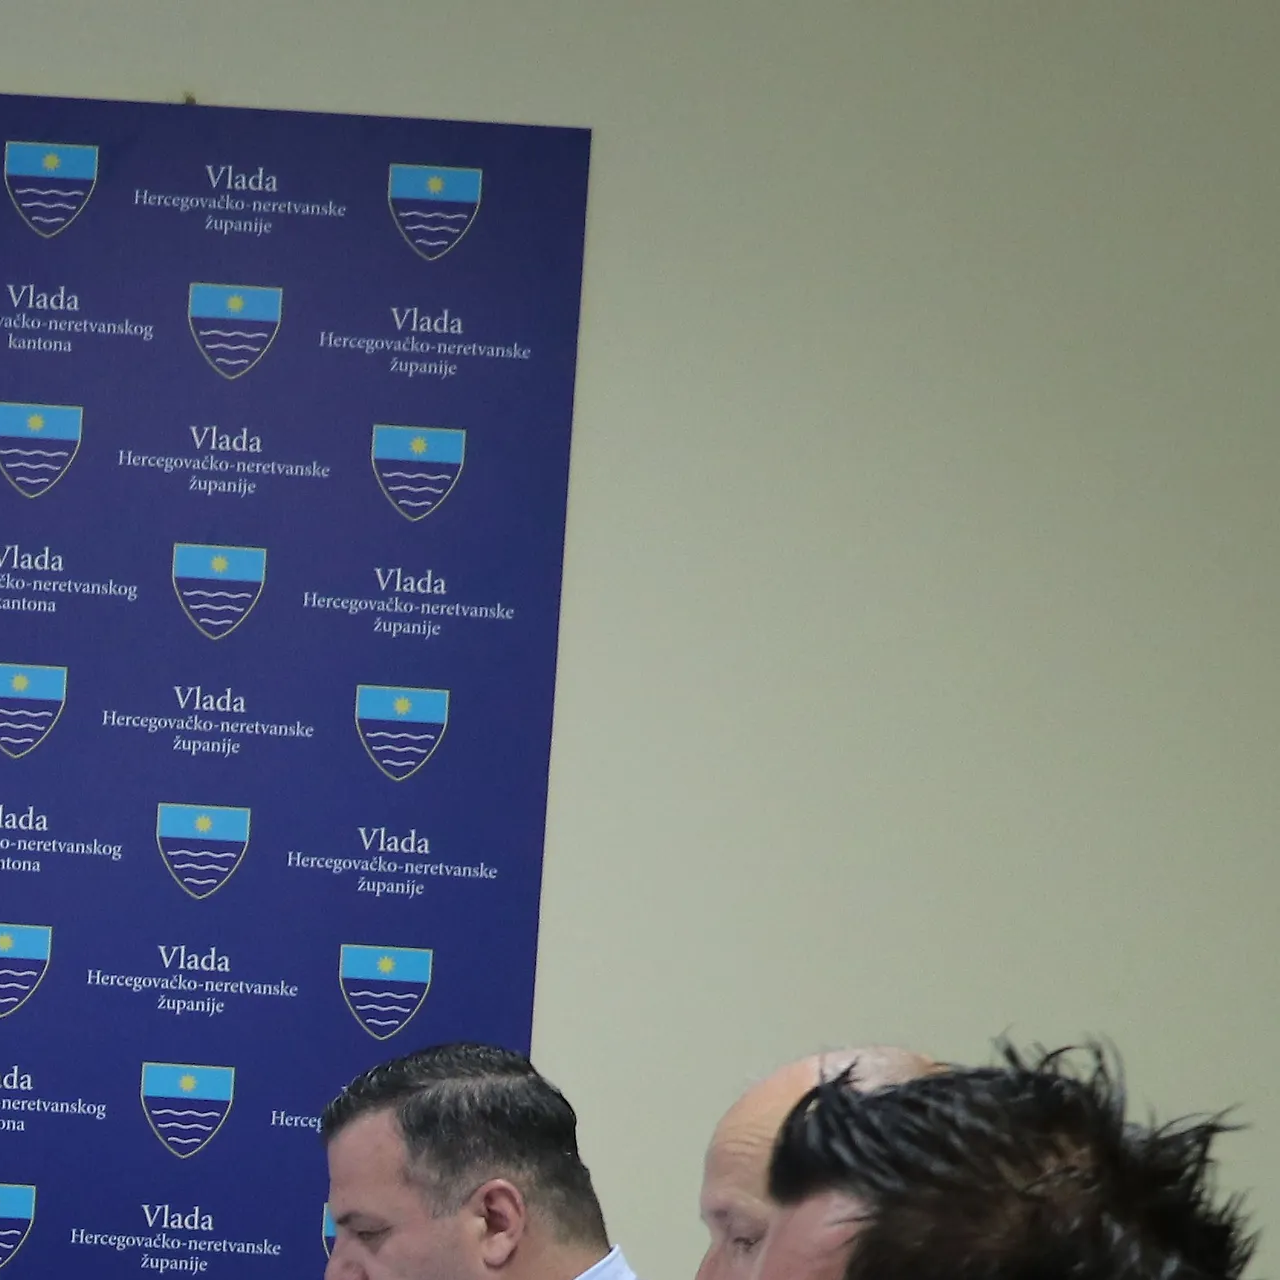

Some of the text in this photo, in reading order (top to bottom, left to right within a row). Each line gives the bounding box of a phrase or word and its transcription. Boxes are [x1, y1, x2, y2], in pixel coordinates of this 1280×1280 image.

[205, 164, 278, 192] Vlada
[135, 189, 346, 216] Hercegovačko-neretvanske
[205, 213, 272, 237] županije
[7, 283, 80, 311] Vlada
[390, 307, 463, 335] Vlada
[8, 331, 72, 352] kantona
[320, 332, 531, 359] Hercegovačko-neretvanske
[390, 356, 457, 380] županije
[189, 425, 262, 453] Vlada
[119, 450, 330, 477] Hercegovačko-neretvanske
[189, 474, 256, 498] županije
[374, 567, 447, 595] Vlada
[304, 592, 515, 619] Hercegovačko-neretvanske
[374, 616, 441, 640] županije
[173, 685, 246, 713] Vlada
[103, 710, 314, 737] Hercegovačko-neretvanske
[173, 734, 240, 758] županije
[358, 826, 431, 854] Vlada
[288, 851, 499, 878] Hercegovačko-neretvanske
[358, 875, 425, 899] županije
[158, 944, 231, 972] Vlada
[88, 969, 299, 996] Hercegovačko-neretvanske
[158, 993, 225, 1017] županije
[141, 1203, 214, 1231] Vlada
[71, 1228, 282, 1255] Hercegovačko-neretvanske
[141, 1252, 208, 1276] županije
